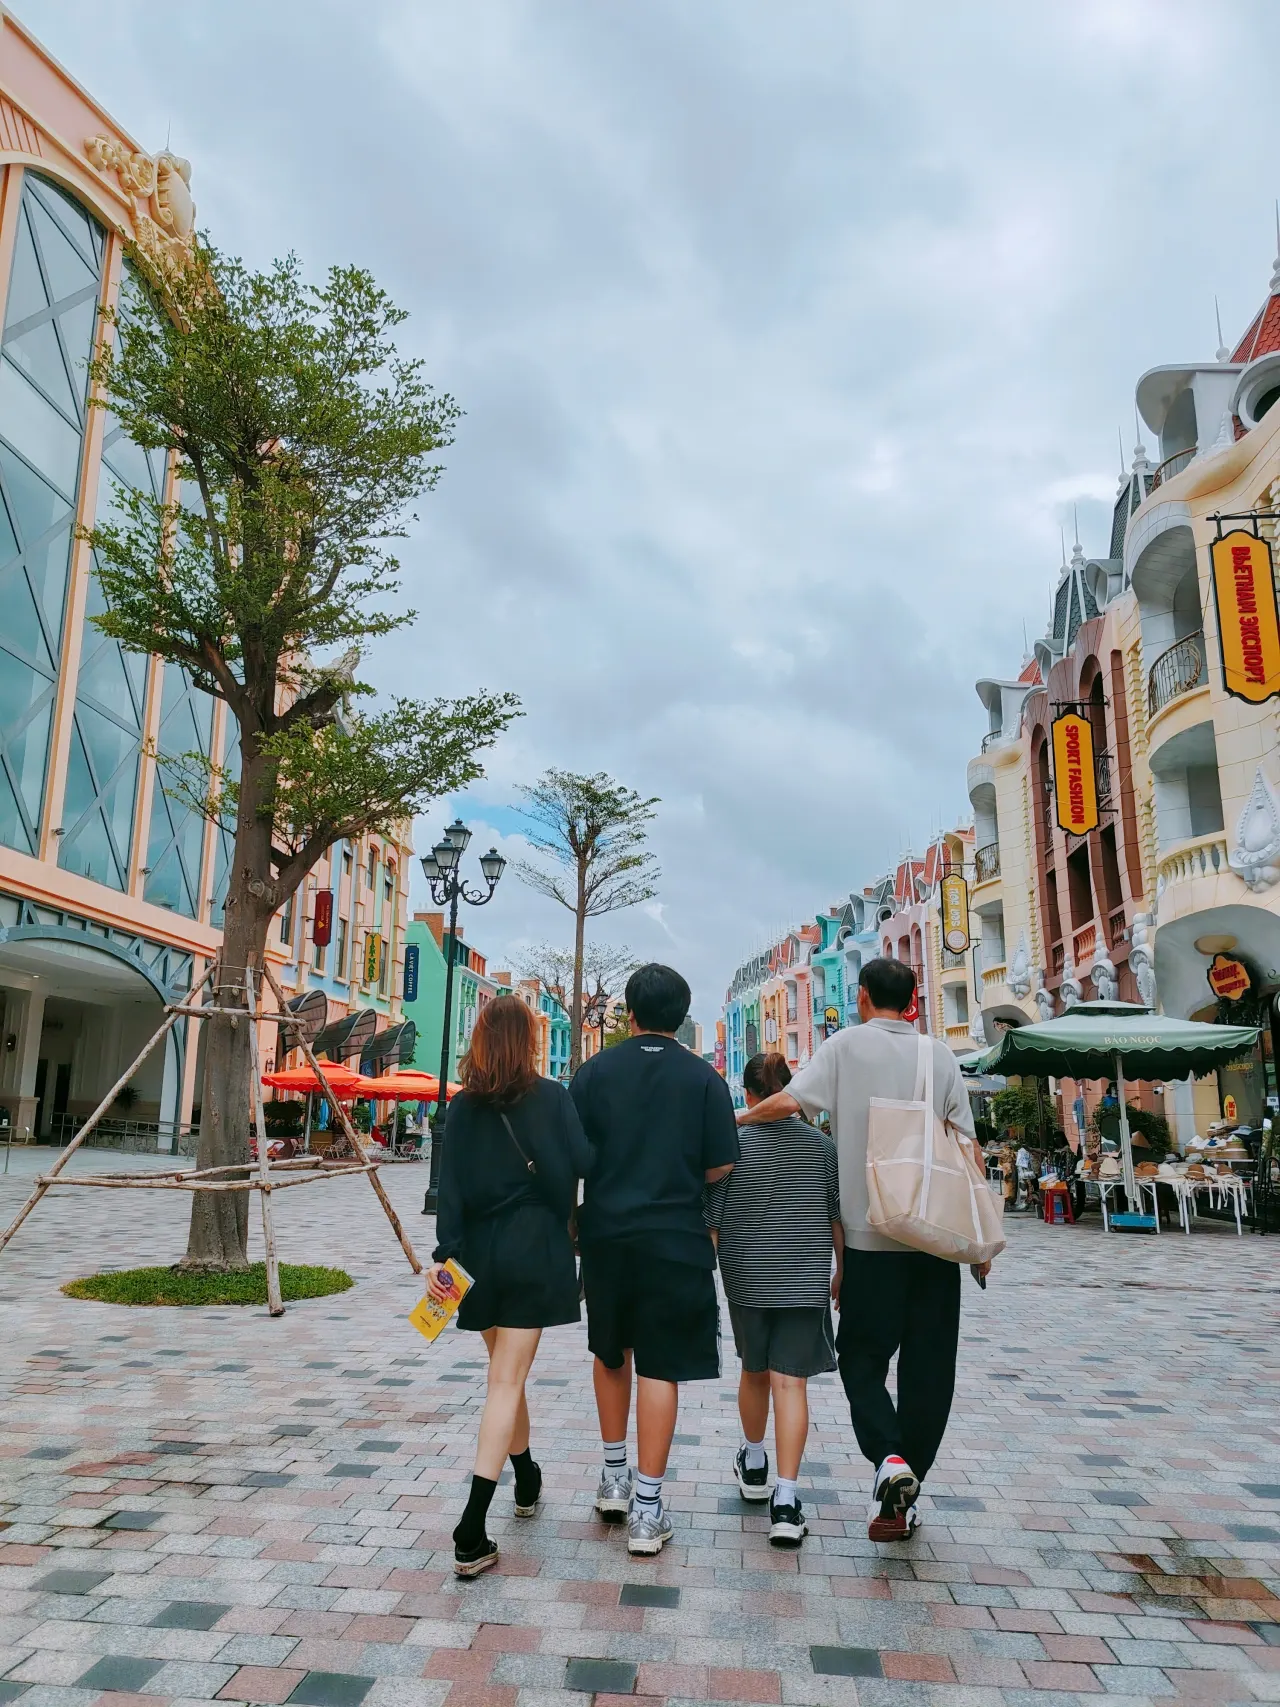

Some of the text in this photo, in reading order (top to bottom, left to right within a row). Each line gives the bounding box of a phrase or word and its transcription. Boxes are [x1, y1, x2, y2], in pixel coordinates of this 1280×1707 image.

[1239, 616, 1265, 685] ЭКСПОРТ
[1065, 724, 1085, 824] SPORT FASHION
